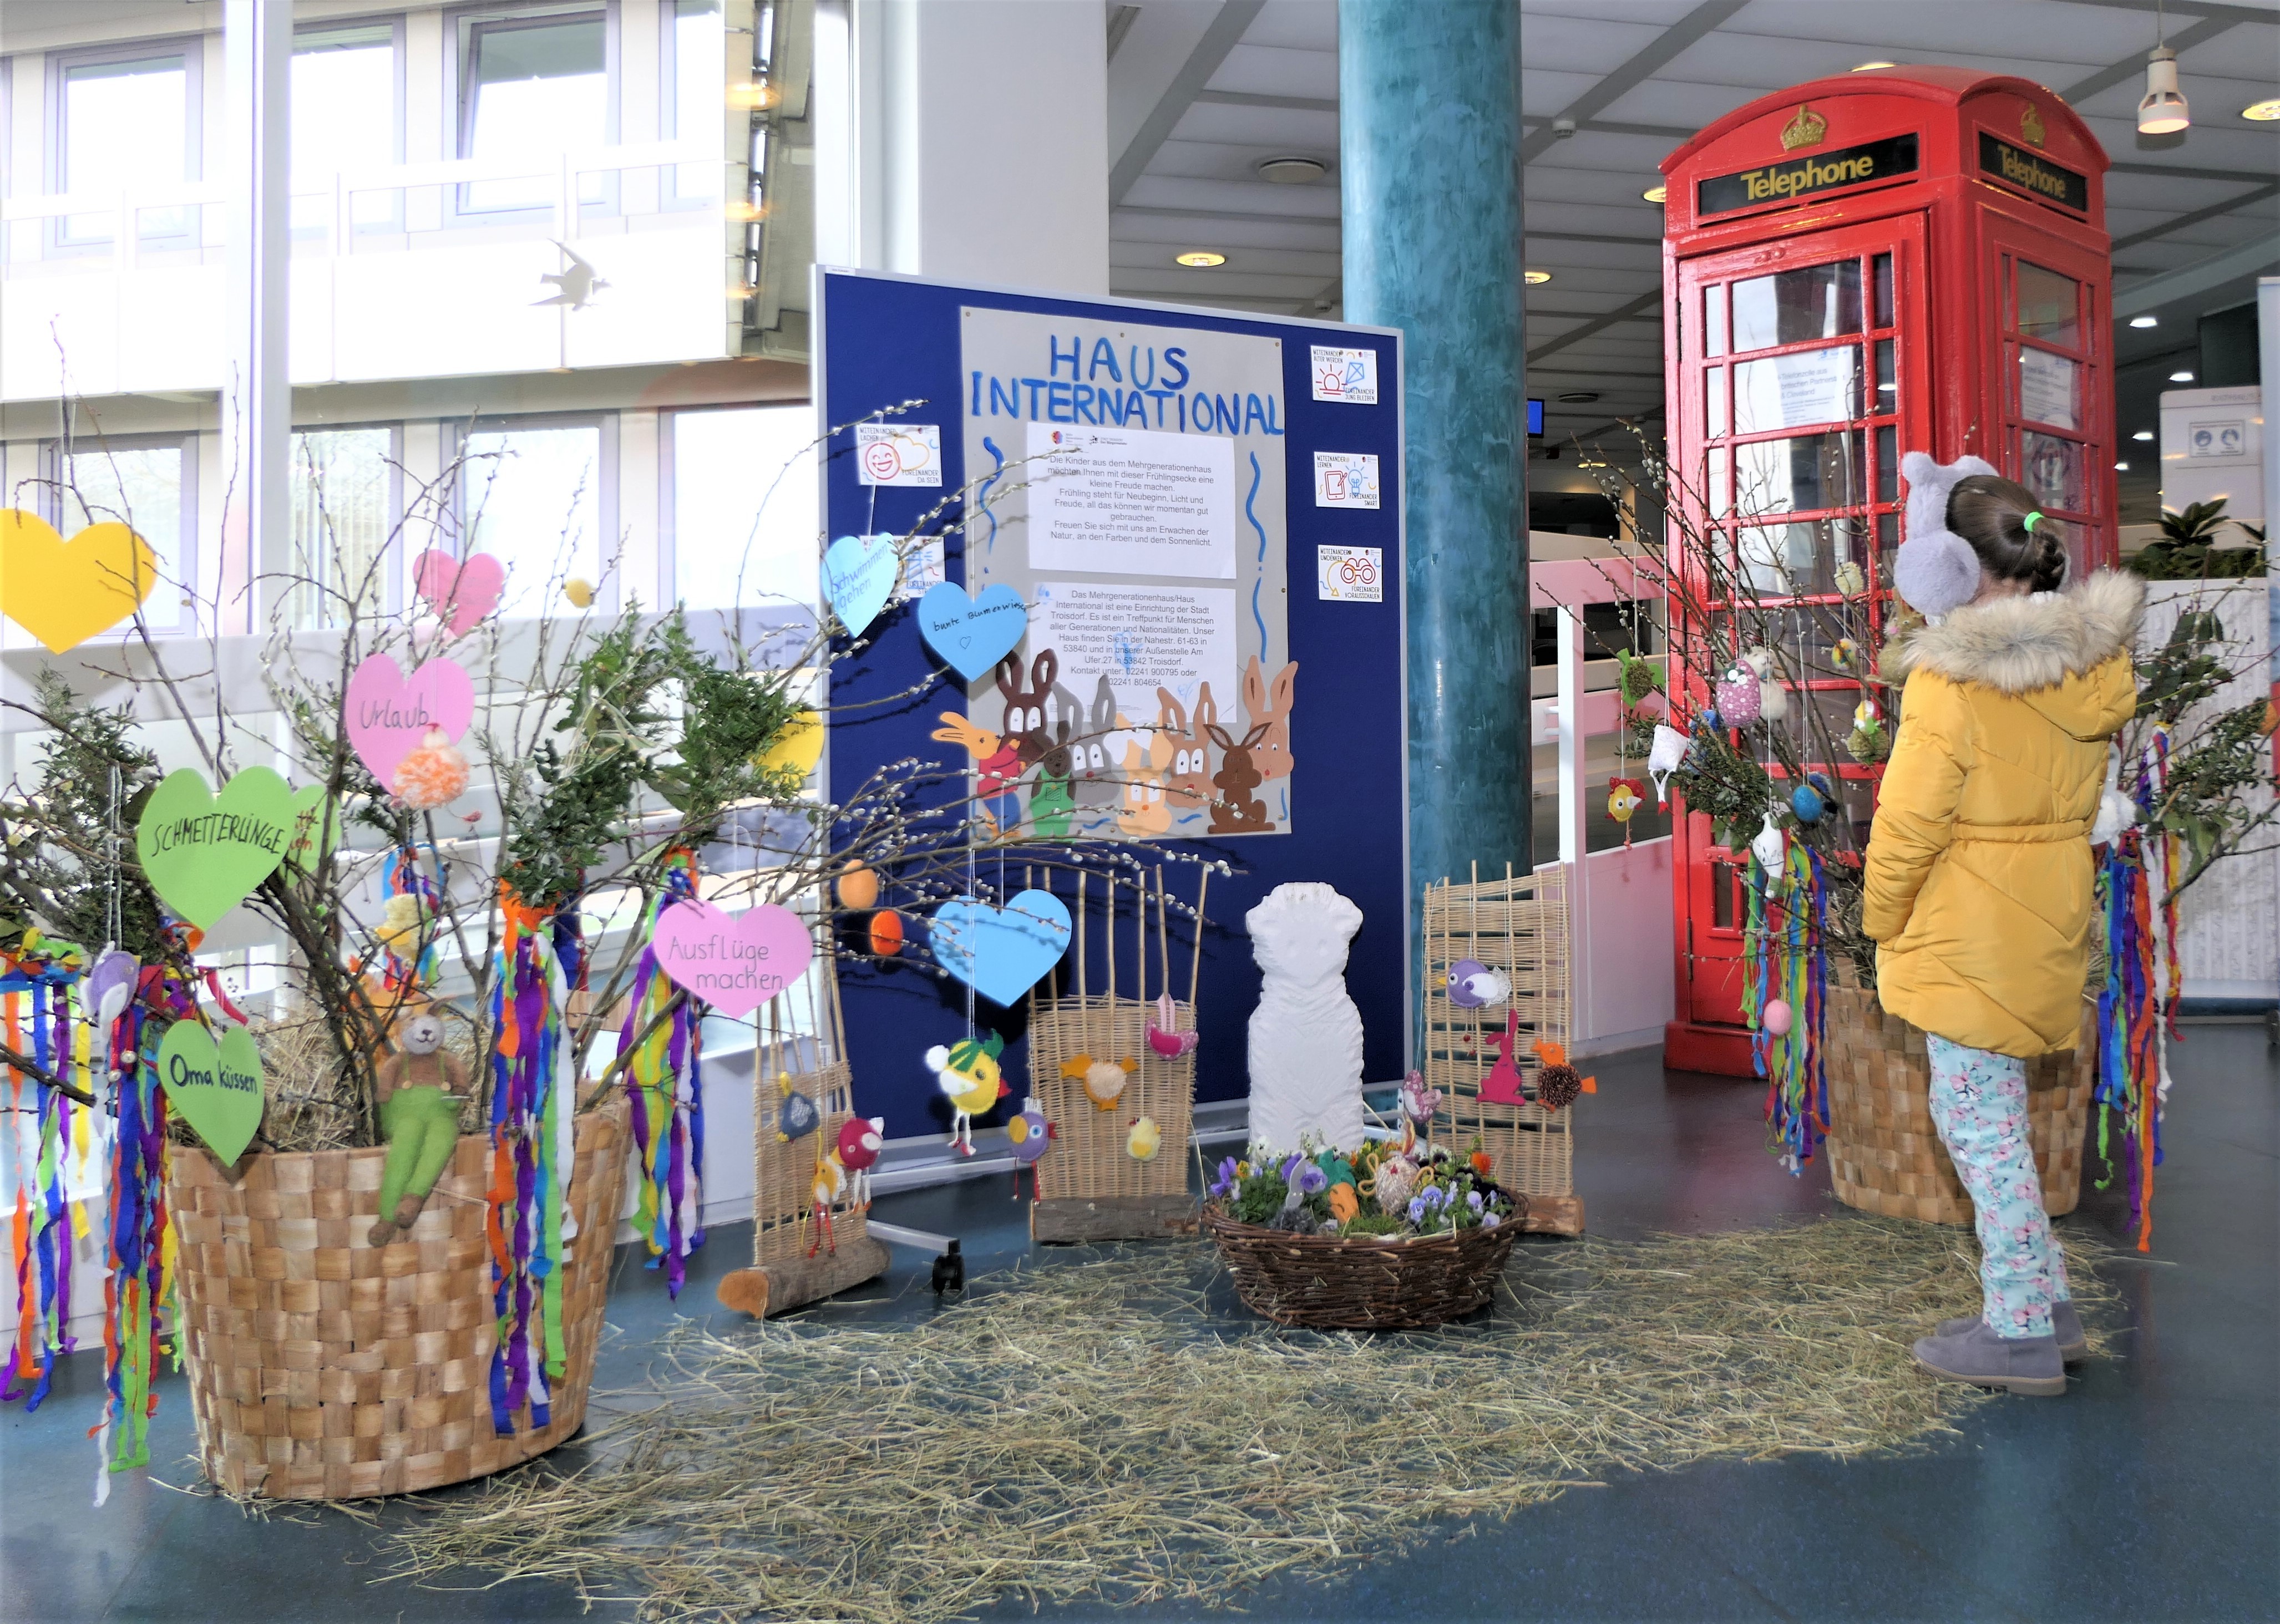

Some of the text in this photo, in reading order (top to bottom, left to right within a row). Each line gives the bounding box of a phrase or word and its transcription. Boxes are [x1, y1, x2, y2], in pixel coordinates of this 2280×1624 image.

[1740, 156, 1873, 200] Telephone
[1998, 144, 2066, 199] Telephone
[1050, 334, 1190, 390] HAUS
[972, 371, 1285, 435] INTERNATIONAL
[1050, 455, 1063, 464] Die
[1066, 456, 1090, 466] Kinder
[1108, 459, 1126, 468] dem
[1128, 460, 1212, 474] Mehrgenerationenhaus
[1047, 466, 1081, 475] möchten
[1083, 468, 1105, 477] Ihnen
[1121, 470, 1144, 479] dieser
[1146, 472, 1197, 484] Frühlingsecke
[1090, 479, 1175, 492] kleine Freude machen.
[1060, 488, 1091, 499] Frühling
[1093, 490, 1112, 499] steht
[1127, 492, 1169, 503] Neubeginn,
[1171, 495, 1188, 503] Licht
[1190, 496, 1204, 504] und
[1055, 499, 1085, 509] Freude,
[1098, 501, 1112, 509] das
[1114, 502, 1142, 511] können
[1144, 504, 1155, 512] wir
[1157, 505, 1195, 514] momentan
[1197, 507, 1208, 516] gut
[1110, 512, 1157, 524] gebrauchen.
[1055, 520, 1082, 529] Freuen
[1100, 522, 1114, 531] sich
[1159, 526, 1195, 535] Erwachen
[1051, 531, 1075, 540] Natur,
[1090, 532, 1103, 541] den
[1106, 534, 1132, 542] Farben
[1151, 536, 1166, 544] dem
[1168, 537, 1212, 547] Sonnenlicht.
[832, 544, 888, 594] Schwimmen
[840, 578, 871, 615] gehen
[1072, 590, 1195, 605] Das Mehrgenerationenhaus/Haus
[1056, 600, 1103, 610] International
[1134, 603, 1174, 615] Einrichtung
[1177, 605, 1188, 613] der
[1190, 606, 1209, 614] Stadt
[934, 618, 959, 631] bunte
[1051, 611, 1087, 621] Troisdorf.
[1113, 613, 1124, 622] ein
[1127, 614, 1163, 625] Treffpunkt
[1177, 616, 1214, 625] Menschen
[1050, 622, 1066, 631] aller
[1069, 623, 1121, 632] Generationen
[1139, 625, 1191, 635] Nationalitäten.
[1193, 627, 1215, 636] Unser
[1059, 633, 1080, 642] Haus
[1081, 634, 1104, 642] finden
[1107, 635, 1119, 643] Sie
[1131, 635, 1142, 643] der
[1144, 636, 1176, 644] Nahestr.
[1178, 637, 1199, 645] 61-63
[1063, 644, 1087, 653] 53840
[1145, 646, 1189, 656] Außenstelle
[1085, 656, 1112, 664] Ufer.27
[1124, 657, 1147, 665] 53842
[1149, 657, 1184, 666] Troisdorf.
[1071, 666, 1101, 675] Kontakt
[1126, 667, 1148, 676] 02241
[1152, 668, 1179, 676] 900795
[1134, 678, 1162, 687] 804654
[361, 692, 429, 729] Urlaub
[669, 935, 769, 973] Ausflüge
[696, 965, 783, 990] machen
[170, 1054, 258, 1095] Oma küssen
